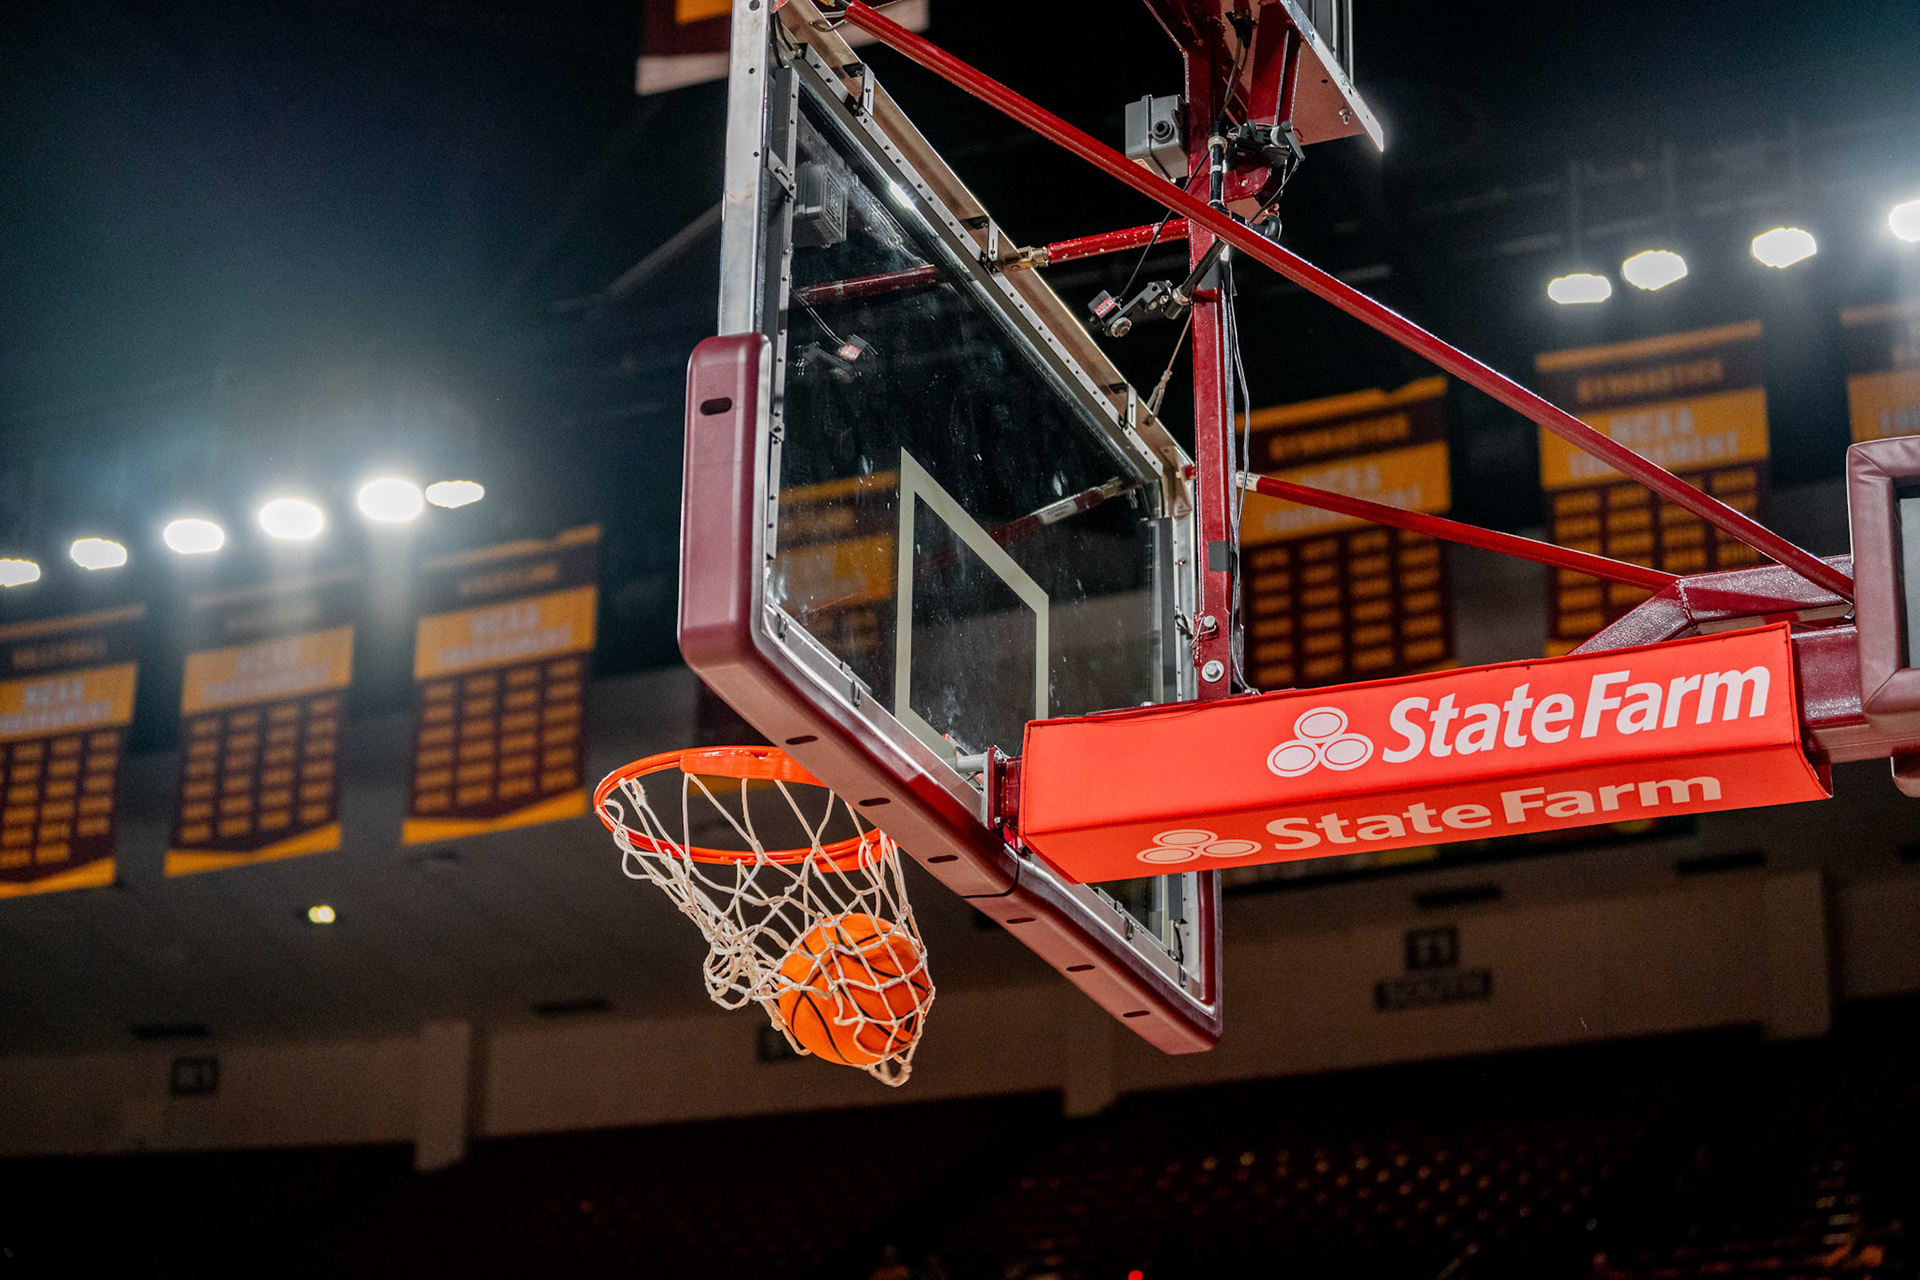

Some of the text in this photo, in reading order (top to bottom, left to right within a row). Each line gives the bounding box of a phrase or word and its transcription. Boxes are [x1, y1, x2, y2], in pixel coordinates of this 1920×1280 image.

[1383, 666, 1770, 763] State Farm
[1267, 777, 1721, 849] State Farm
